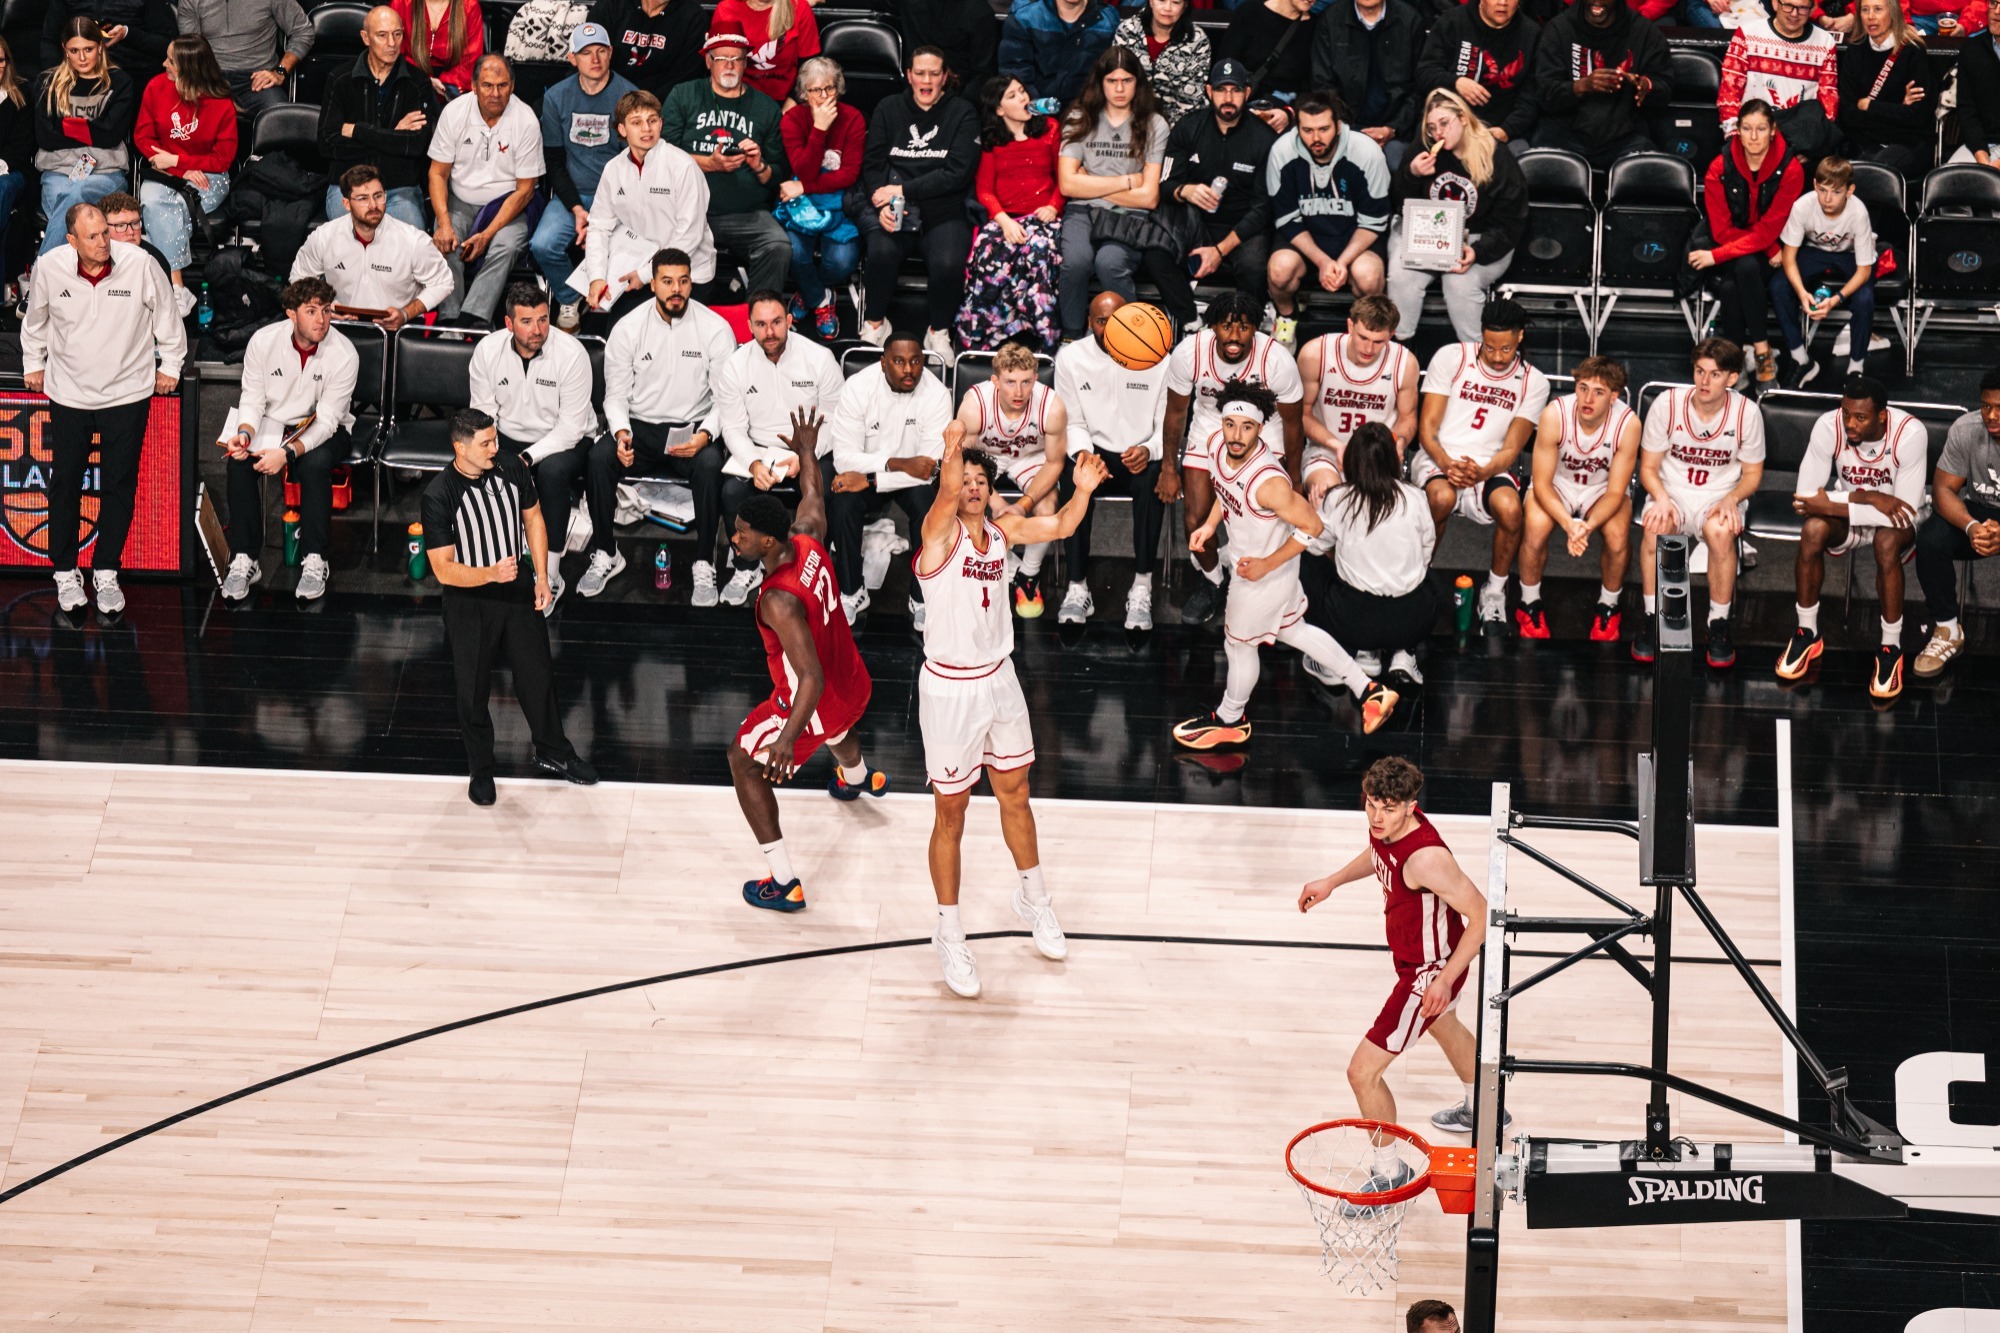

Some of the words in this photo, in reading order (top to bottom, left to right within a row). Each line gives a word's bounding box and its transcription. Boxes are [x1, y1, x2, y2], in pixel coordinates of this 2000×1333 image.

[622, 30, 666, 49] EAGES
[1456, 41, 1471, 76] STERN
[1572, 43, 1581, 81] STERN
[1224, 63, 1232, 75] S
[1870, 59, 1894, 98] EASTERN
[696, 110, 753, 138] SANTA!
[890, 147, 948, 158] Basketball
[1437, 240, 1450, 250] 40
[1326, 388, 1387, 402] EASTERN
[1460, 390, 1514, 412] WASHINGTON
[1463, 381, 1517, 402] EASTERN
[1324, 397, 1386, 410] WASHINGTON
[1471, 407, 1488, 430] 5
[1671, 444, 1732, 458] EASTERN
[1671, 450, 1731, 466] WASHINGTON
[1574, 473, 1588, 485] 11
[1688, 467, 1709, 486] 10
[800, 549, 821, 588] OKAFOR
[982, 587, 990, 612] 1
[1628, 1174, 1764, 1206] SPALDING
